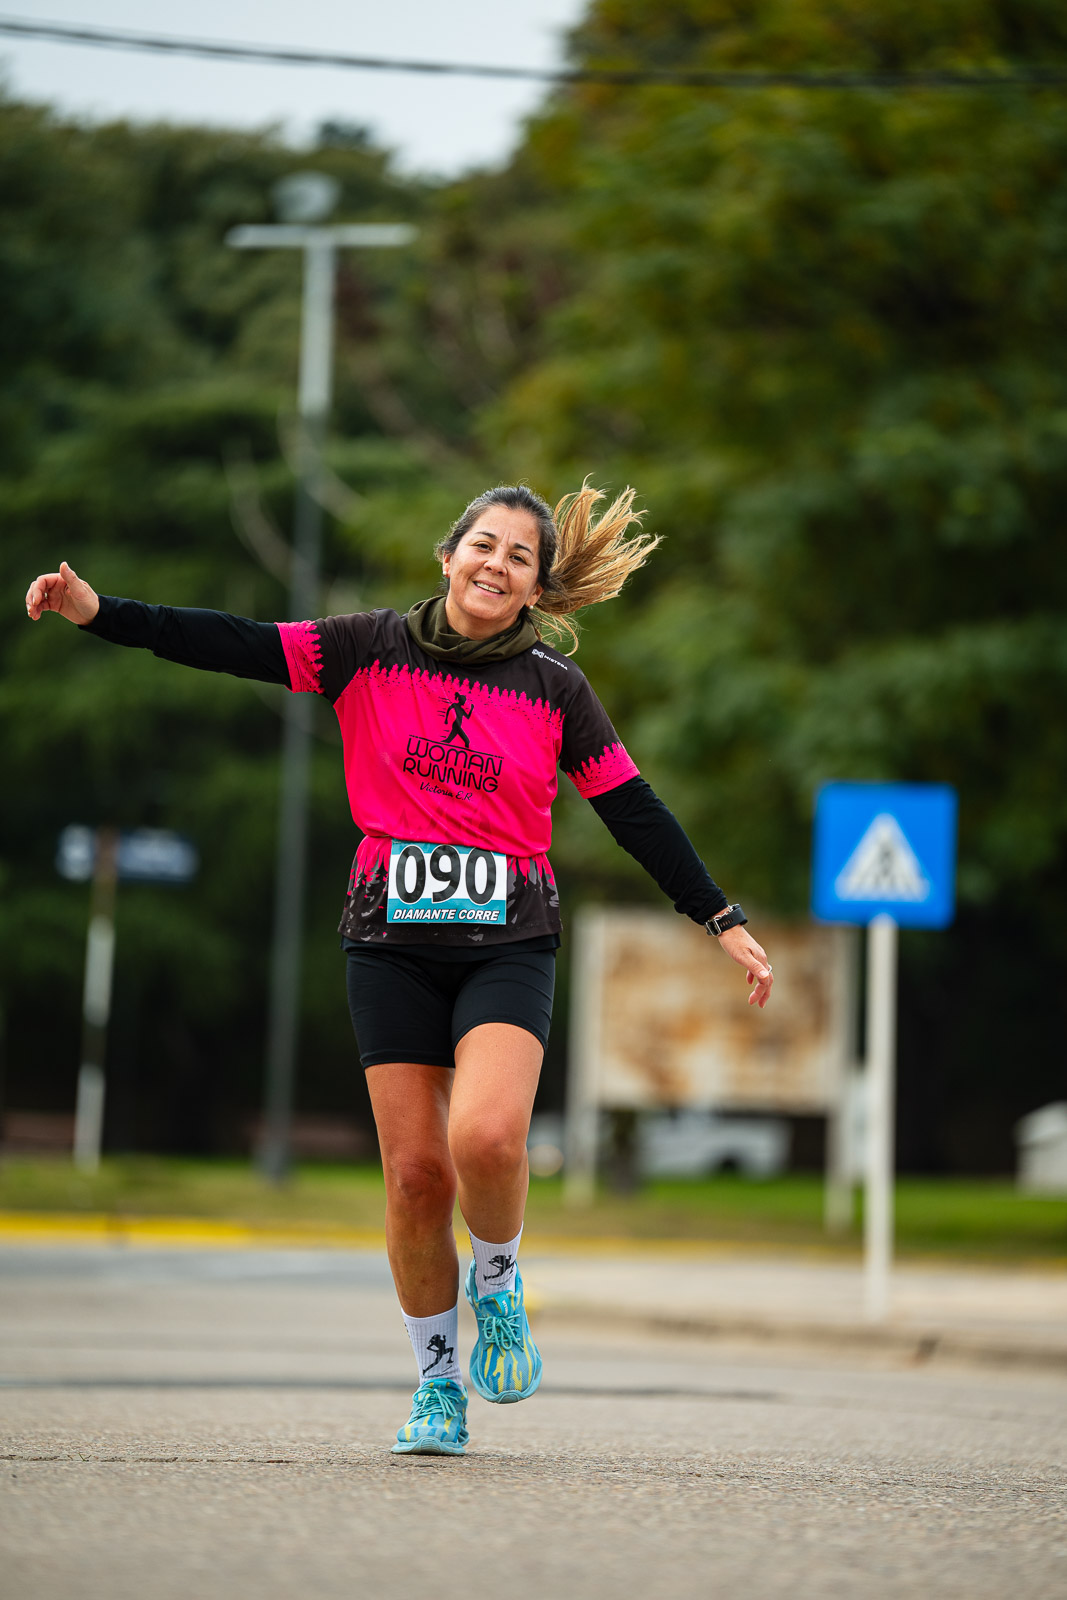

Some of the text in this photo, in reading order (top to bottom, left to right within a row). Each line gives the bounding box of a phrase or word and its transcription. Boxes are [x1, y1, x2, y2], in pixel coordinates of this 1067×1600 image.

[403, 757, 498, 793] RUNNING
[406, 737, 503, 777] WOMAN
[420, 781, 454, 798] Victoria
[395, 843, 497, 906] 090
[392, 908, 500, 921] DIAMANTE CORRE
